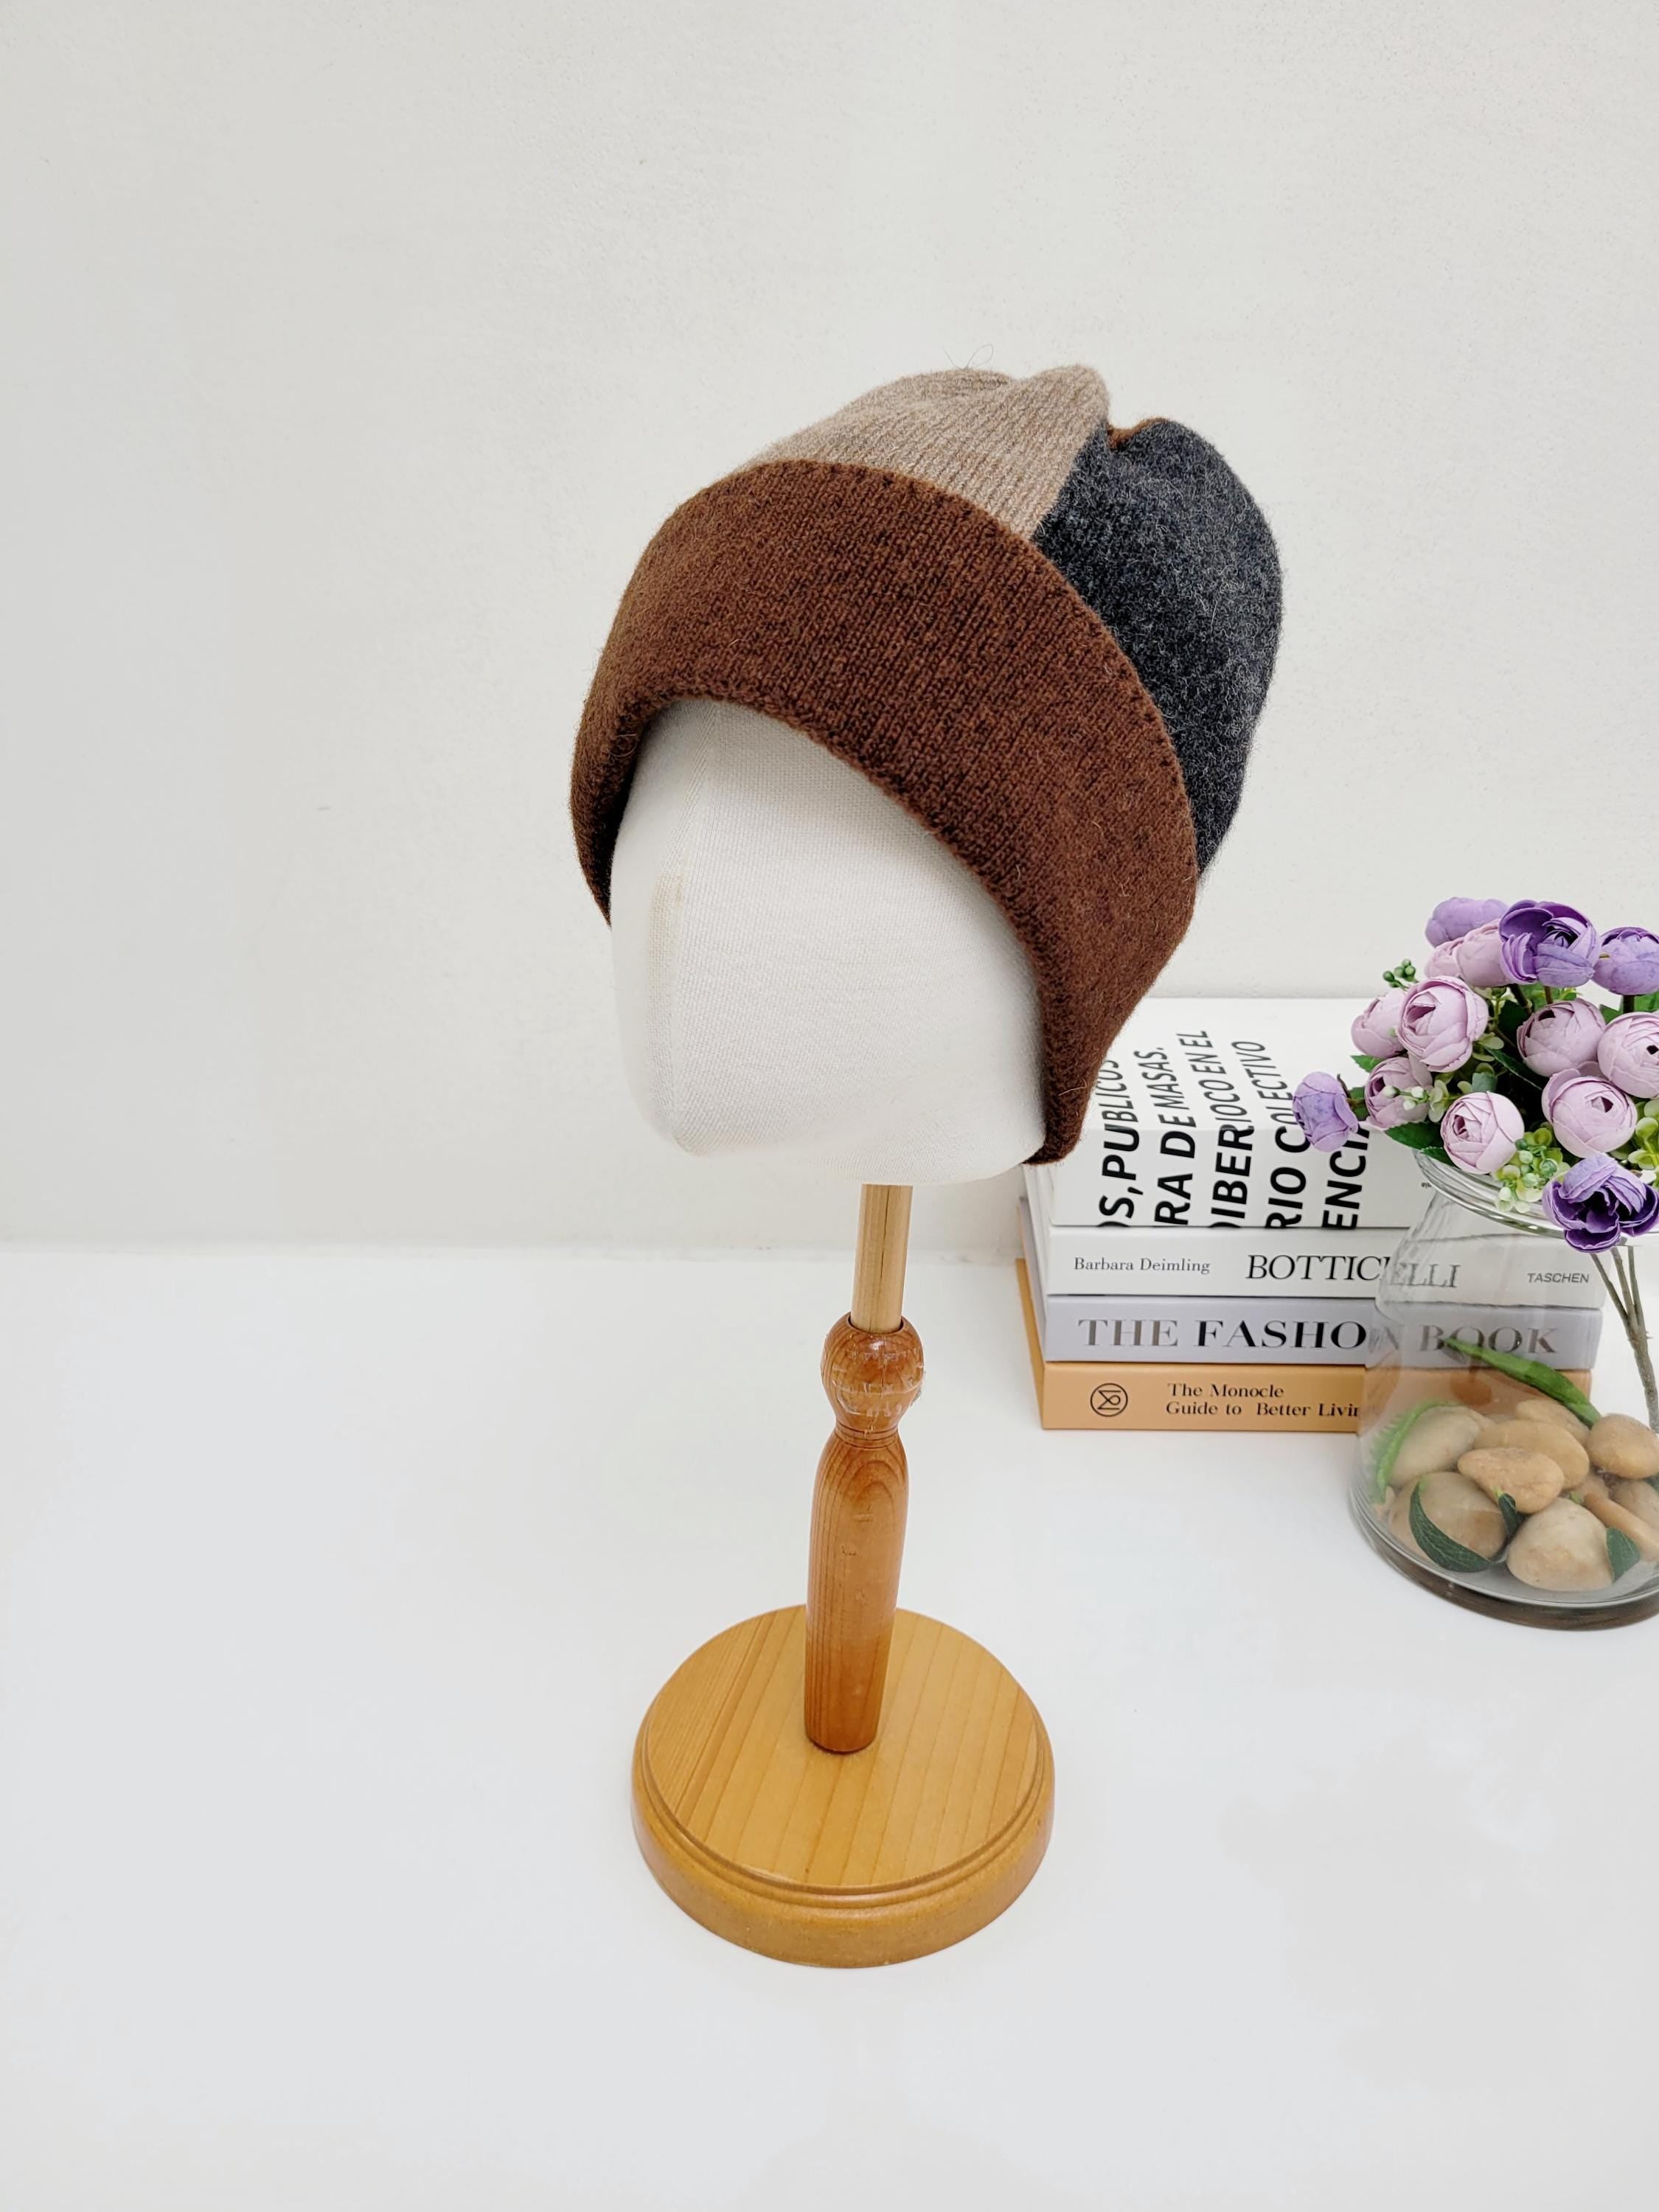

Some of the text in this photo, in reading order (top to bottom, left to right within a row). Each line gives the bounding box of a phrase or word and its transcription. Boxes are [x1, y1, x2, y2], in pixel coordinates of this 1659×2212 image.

[1133, 1047, 1189, 1110] MASAS.
[1158, 1114, 1197, 1158] DE
[1176, 1031, 1254, 1228] IBERIOCO EN EL
[1074, 1257, 1134, 1270] Barbara
[1140, 1258, 1211, 1274] Deimling
[1528, 1273, 1589, 1284] TASCHEN
[1078, 1319, 1178, 1346] THE
[1419, 1324, 1557, 1353] BOOK
[1168, 1383, 1284, 1398] The Monocle
[1166, 1402, 1218, 1415] Guide
[1225, 1403, 1242, 1416] to
[1256, 1402, 1311, 1416] Better
